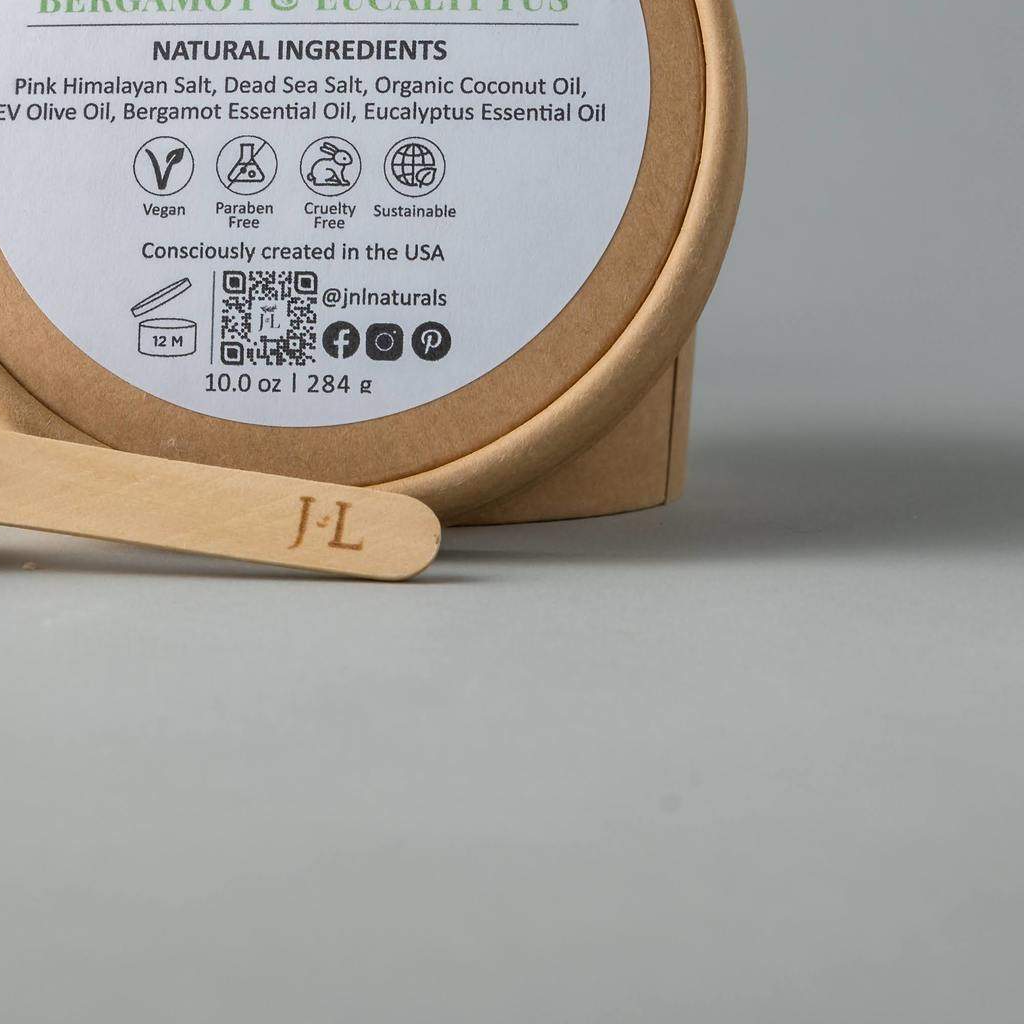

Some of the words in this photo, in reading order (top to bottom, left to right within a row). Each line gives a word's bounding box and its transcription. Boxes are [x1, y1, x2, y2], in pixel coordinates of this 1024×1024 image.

[152, 40, 271, 61] NATURAL
[277, 40, 448, 61] INGREDIENTS
[14, 77, 57, 95] Pink
[63, 76, 168, 98] Himalayan
[173, 76, 217, 96] Salt,
[224, 75, 277, 94] Dead
[282, 76, 318, 94] Sea
[324, 75, 368, 96] Salt,
[374, 76, 454, 98] Organic
[459, 77, 547, 95] Coconut
[552, 77, 587, 98] Oil,
[26, 102, 77, 121] Olive
[83, 102, 116, 123] Oil,
[123, 103, 222, 124] Bergamot
[228, 102, 317, 121] Essential
[323, 101, 357, 123] Oil,
[364, 101, 475, 124] Eucalyptus
[481, 103, 571, 122] Essential
[577, 104, 606, 122] Oil
[143, 203, 186, 218] Vegan
[215, 201, 274, 215] Paraben
[304, 201, 357, 218] Cruelty
[373, 203, 457, 218] Sustainable
[228, 216, 260, 229] Free
[314, 216, 346, 229] Free
[142, 242, 256, 263] Consciously
[261, 242, 336, 261] created
[342, 243, 360, 261] in
[365, 243, 399, 261] the
[404, 244, 445, 262] USA
[321, 288, 447, 308] @jnlnaturals
[152, 335, 167, 348] 12
[171, 335, 184, 348] M
[205, 373, 252, 393] 10.0
[257, 378, 282, 393] oz
[307, 374, 351, 394] 284
[359, 379, 373, 394] g
